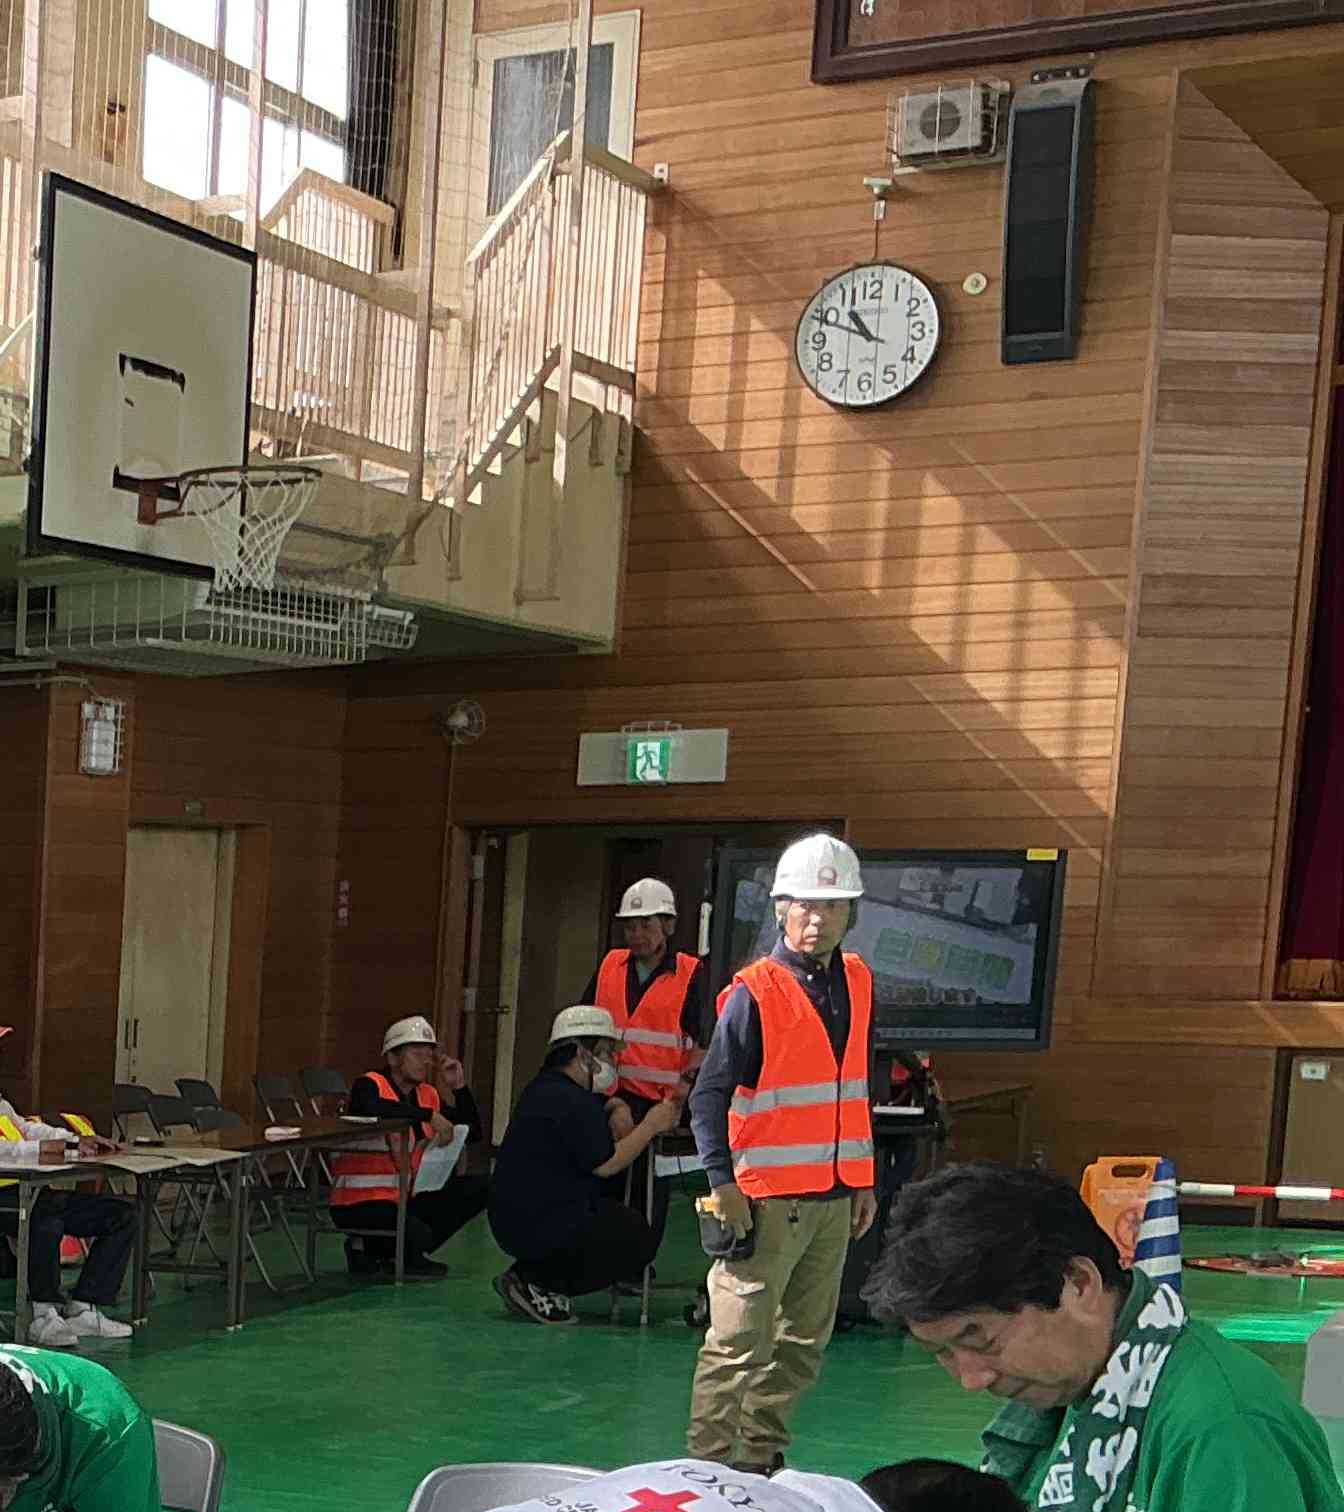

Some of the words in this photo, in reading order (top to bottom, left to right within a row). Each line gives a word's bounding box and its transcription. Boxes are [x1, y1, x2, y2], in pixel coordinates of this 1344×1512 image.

[863, 279, 883, 300] 12
[906, 298, 921, 317] 2
[811, 330, 827, 351] 9
[912, 321, 926, 341] 3
[818, 352, 833, 372] 8
[901, 346, 916, 364] 4
[837, 369, 850, 388] 7
[857, 372, 872, 392] 6
[882, 364, 897, 384] 5
